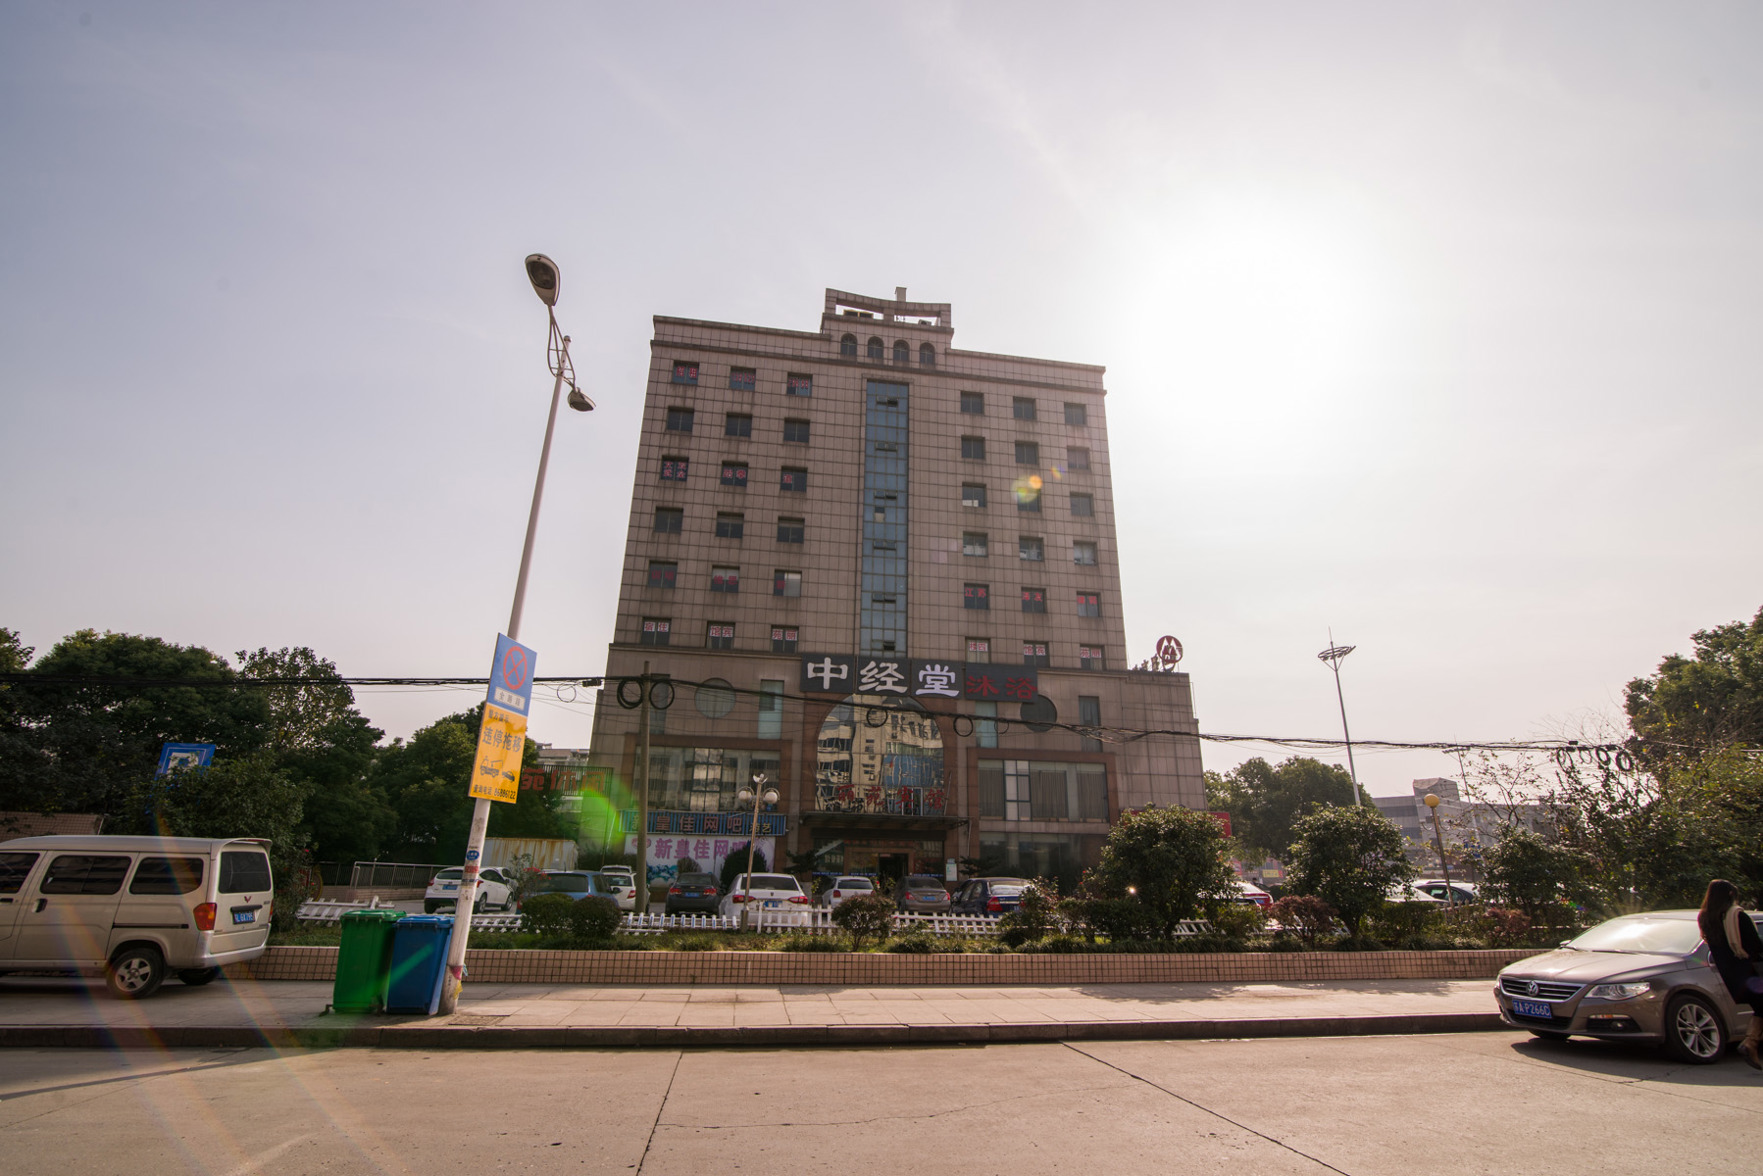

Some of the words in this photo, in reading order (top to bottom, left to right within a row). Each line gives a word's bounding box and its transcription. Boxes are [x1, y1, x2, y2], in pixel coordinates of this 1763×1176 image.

[807, 657, 960, 697] 中经堂
[966, 675, 1037, 699] 沐浴
[482, 727, 522, 753] 违停拖移
